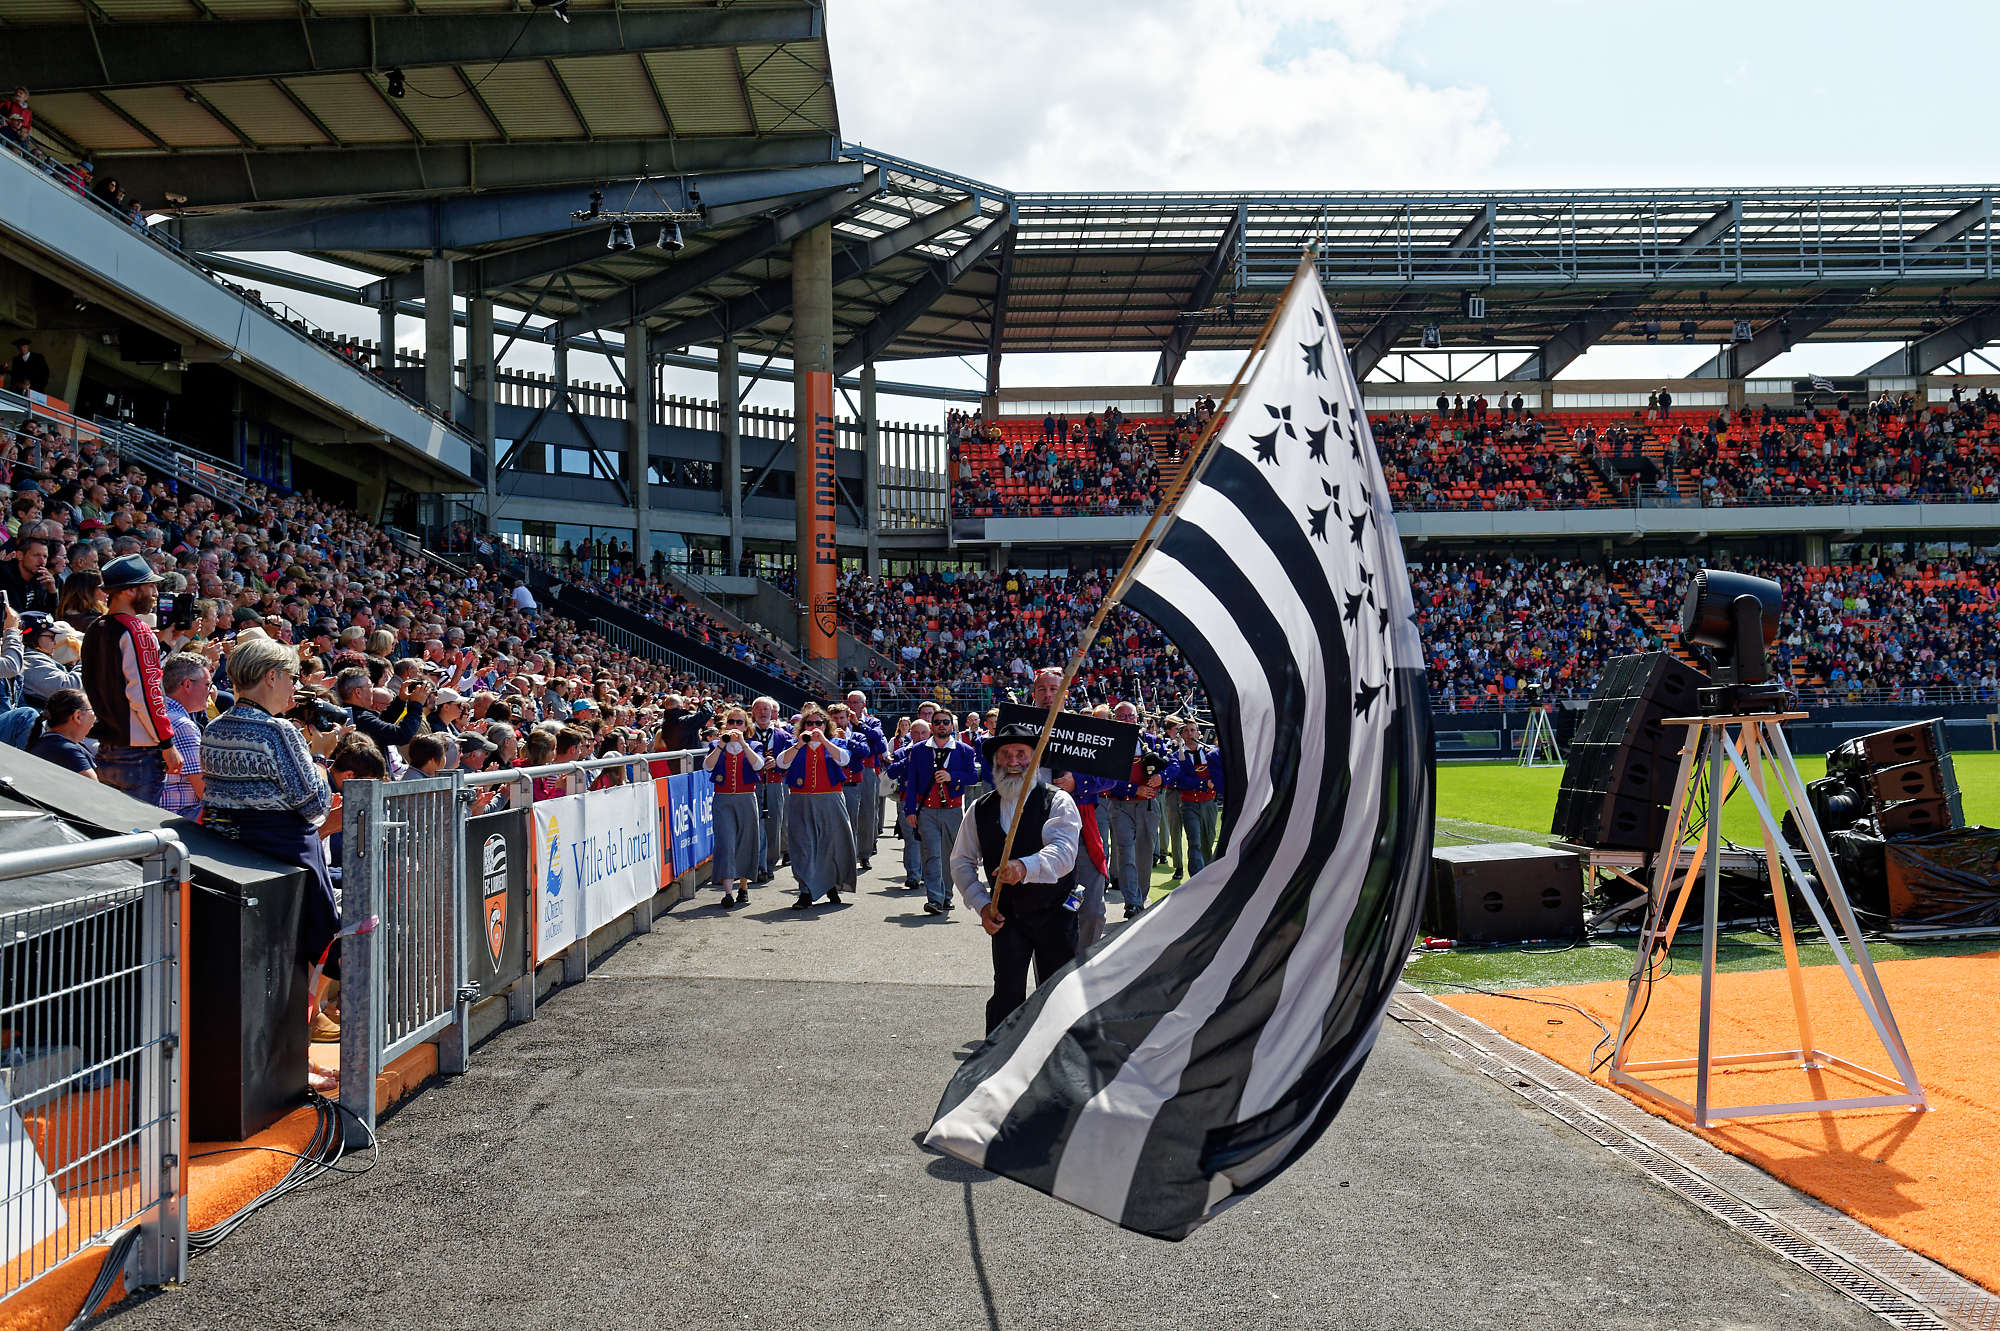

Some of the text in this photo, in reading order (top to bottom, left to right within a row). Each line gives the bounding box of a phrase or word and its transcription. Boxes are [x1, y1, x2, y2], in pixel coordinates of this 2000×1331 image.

[815, 412, 836, 565] FC LORIENT
[1062, 744, 1097, 759] MARK
[1076, 732, 1115, 747] BREST
[571, 835, 602, 890] Ville
[605, 829, 617, 876] de
